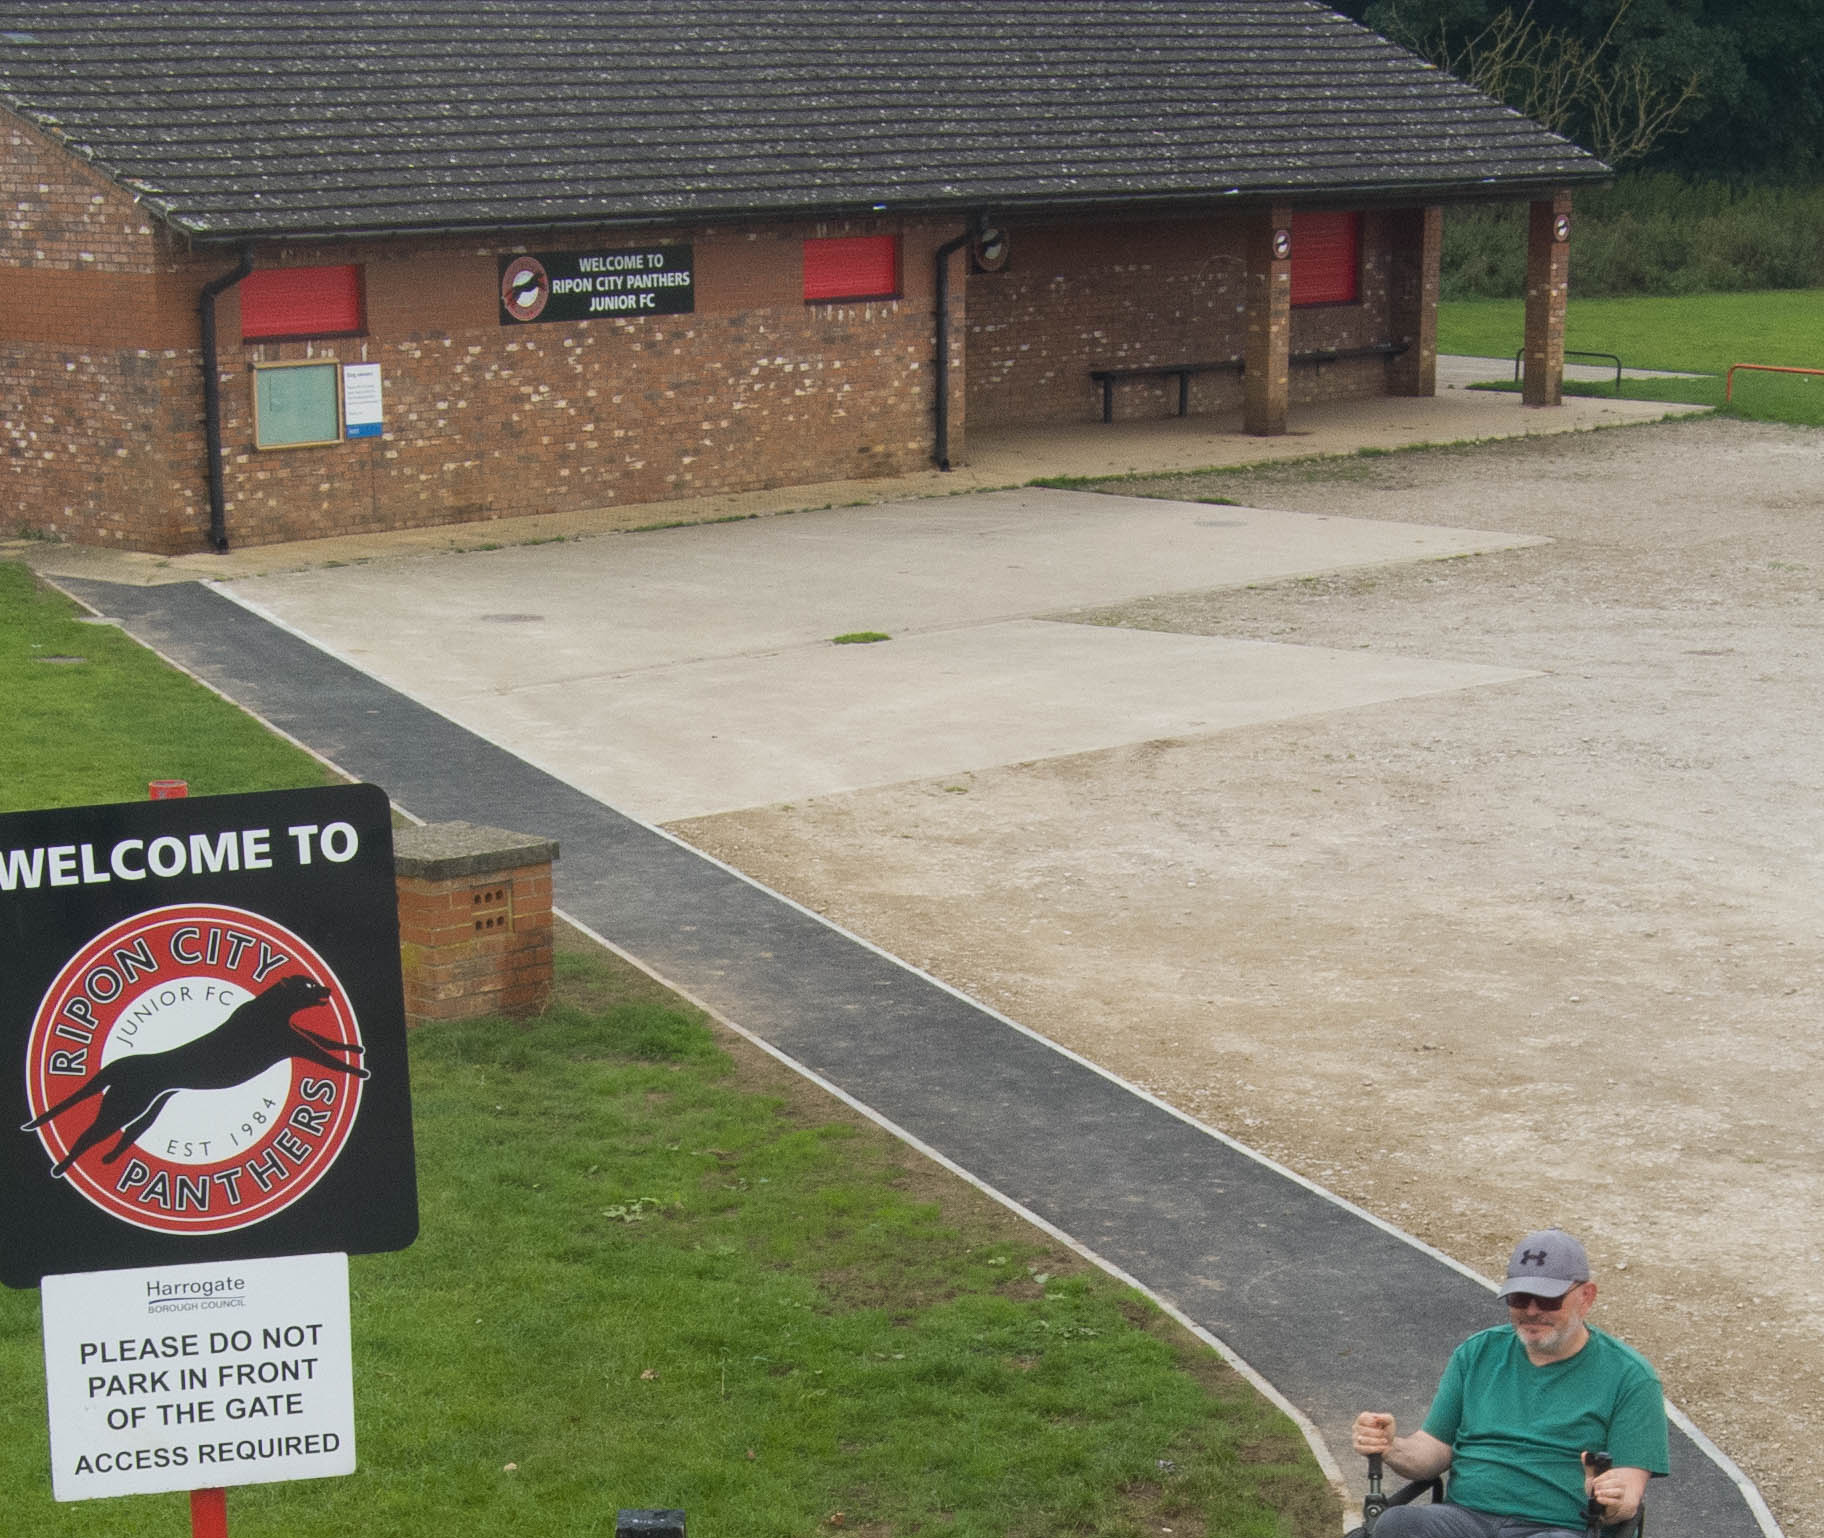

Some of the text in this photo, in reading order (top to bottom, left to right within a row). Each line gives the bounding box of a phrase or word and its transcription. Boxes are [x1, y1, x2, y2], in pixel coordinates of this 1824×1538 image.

[552, 272, 690, 293] RIPON CITY PANTHERS
[579, 254, 664, 272] WELCOME TO
[589, 293, 655, 311] JUNIOR FC
[288, 821, 359, 864] TO
[48, 927, 289, 1076] RIPON CITY
[116, 986, 235, 1047] JUNIOR FC
[118, 1076, 337, 1211] PANTHERS
[166, 1096, 277, 1158] EST 1984
[146, 1276, 245, 1296] Harrogate
[148, 1299, 246, 1314] BOROUGH COUNCIL
[80, 1324, 323, 1364] PLEASE DO NOT
[88, 1358, 318, 1398] PARK IN FRONT
[107, 1393, 303, 1430] OF THE GATE
[74, 1432, 341, 1475] ACCESS REQUIRED
